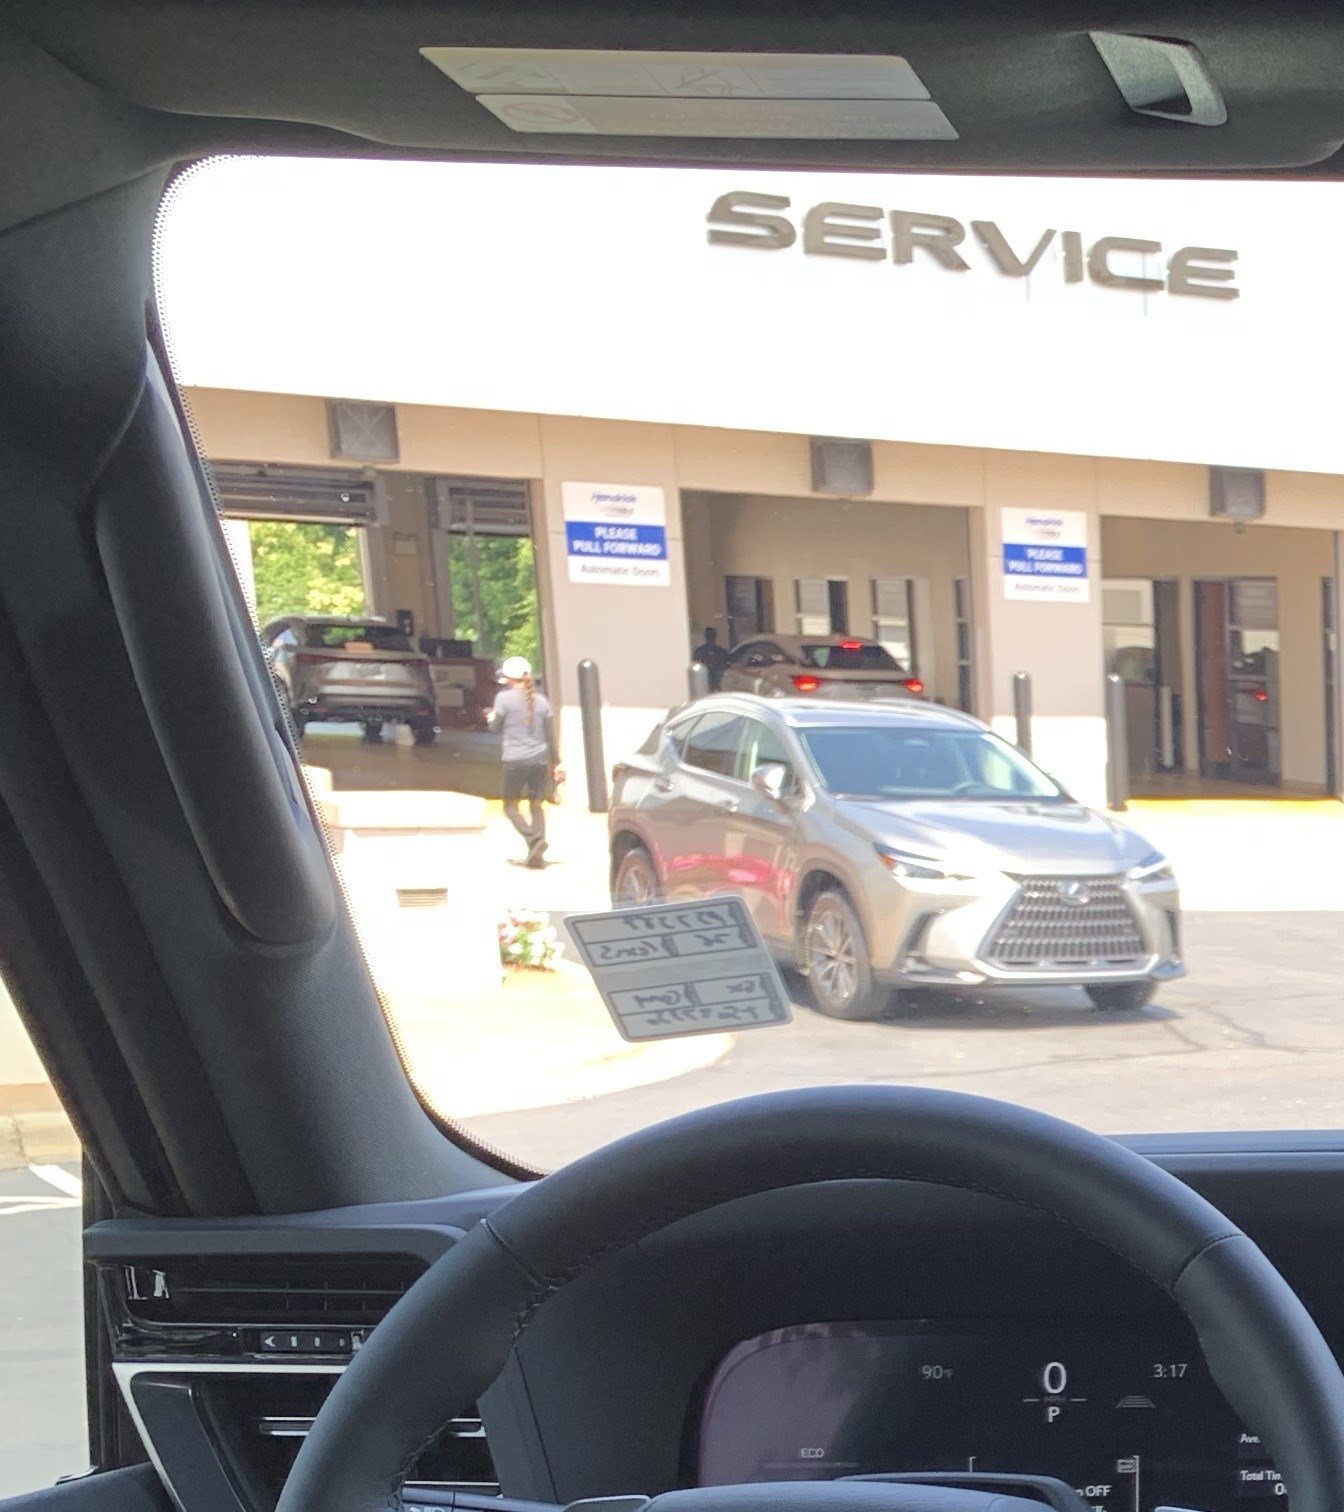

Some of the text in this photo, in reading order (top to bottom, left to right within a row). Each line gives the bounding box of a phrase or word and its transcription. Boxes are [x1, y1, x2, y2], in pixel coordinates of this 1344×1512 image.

[707, 191, 1239, 299] SERVICE
[595, 526, 638, 540] PLEASE
[572, 540, 661, 556] PULL FORWARD
[1043, 1362, 1067, 1394] 0
[1152, 1364, 1188, 1378] 3:17
[1047, 1407, 1060, 1422] P
[1240, 1470, 1264, 1480] Total
[1086, 1485, 1112, 1496] OFF
